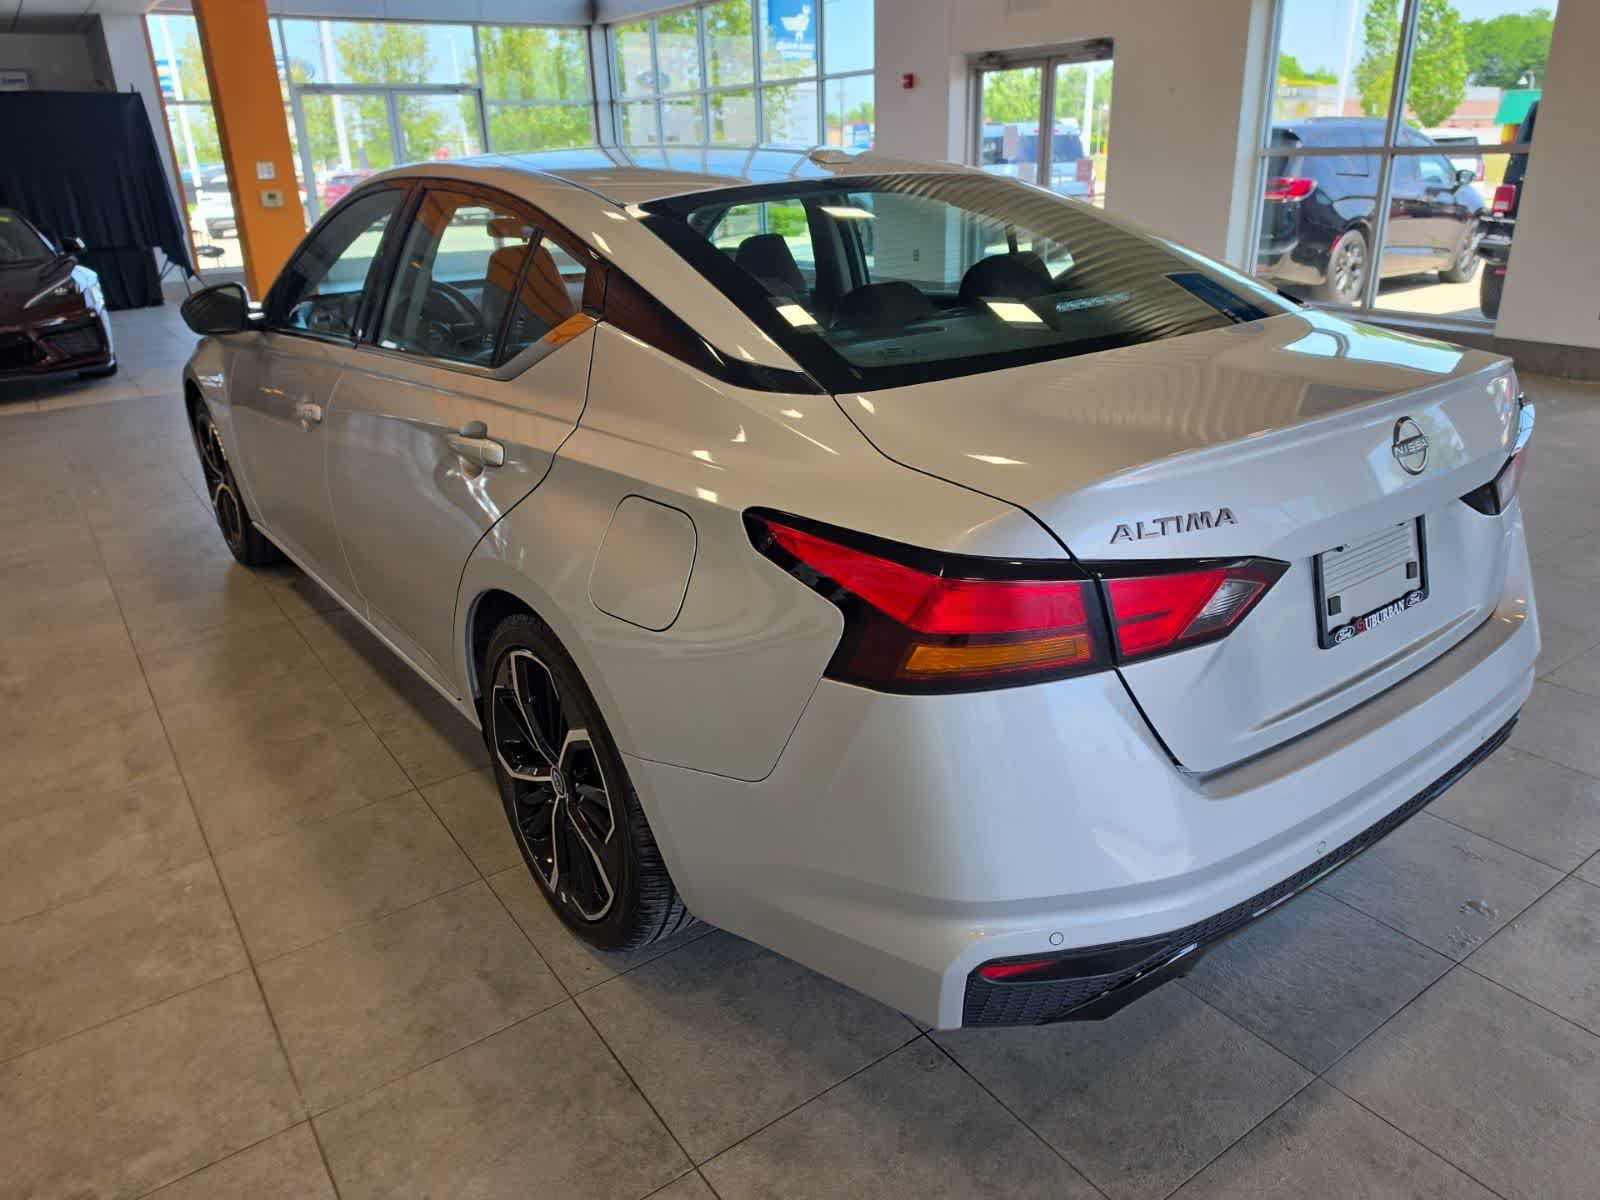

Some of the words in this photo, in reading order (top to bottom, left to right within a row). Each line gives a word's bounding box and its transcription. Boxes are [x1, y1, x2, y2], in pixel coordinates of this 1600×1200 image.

[1394, 437, 1428, 456] NISS
[1109, 507, 1238, 544] ALTIMA
[1355, 599, 1405, 633] SUBURBAN
